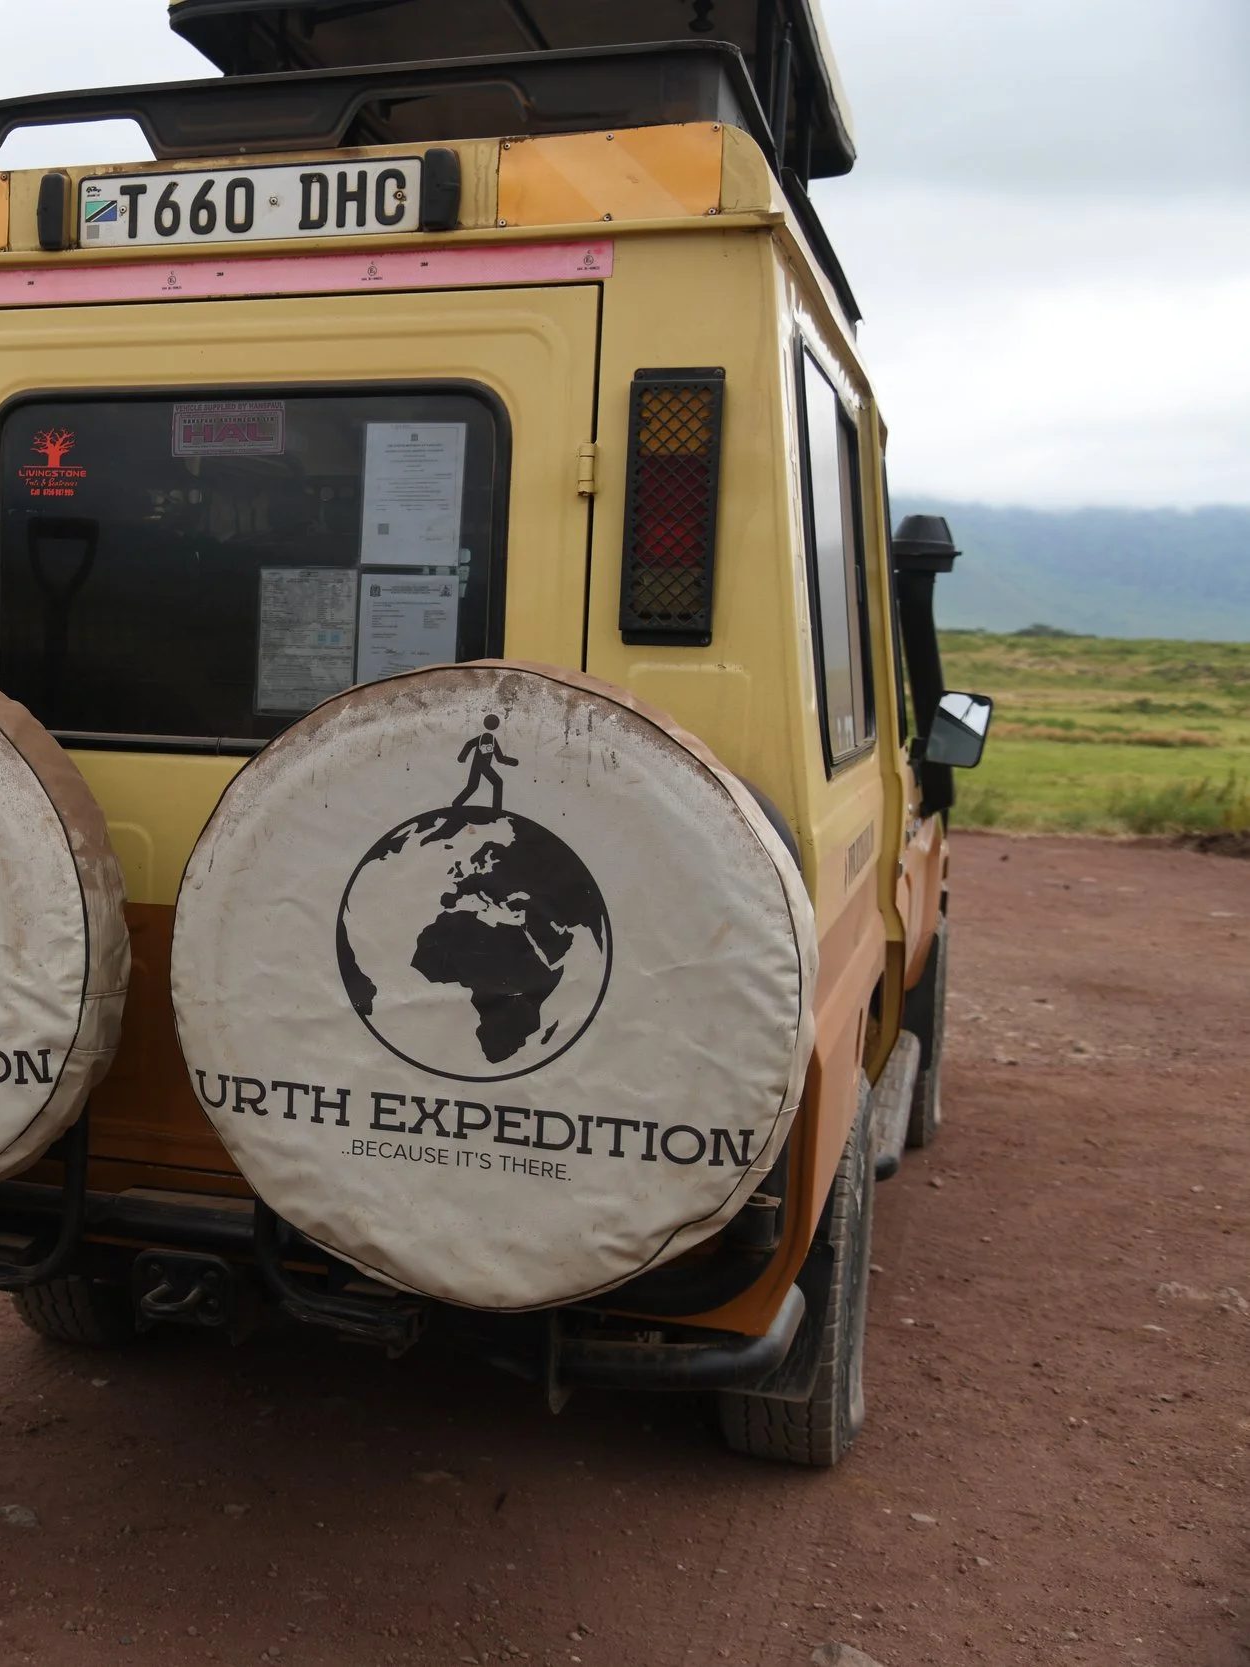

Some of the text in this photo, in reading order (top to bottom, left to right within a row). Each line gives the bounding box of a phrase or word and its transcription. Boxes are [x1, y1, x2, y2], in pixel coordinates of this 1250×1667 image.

[119, 168, 407, 239] T660 DHC
[183, 422, 274, 443] HAL
[18, 470, 87, 478] LIVINGSTONE
[195, 1069, 755, 1167] URTH EXPEDITION
[455, 1150, 492, 1170] IT'S
[499, 1154, 572, 1182] THERE.
